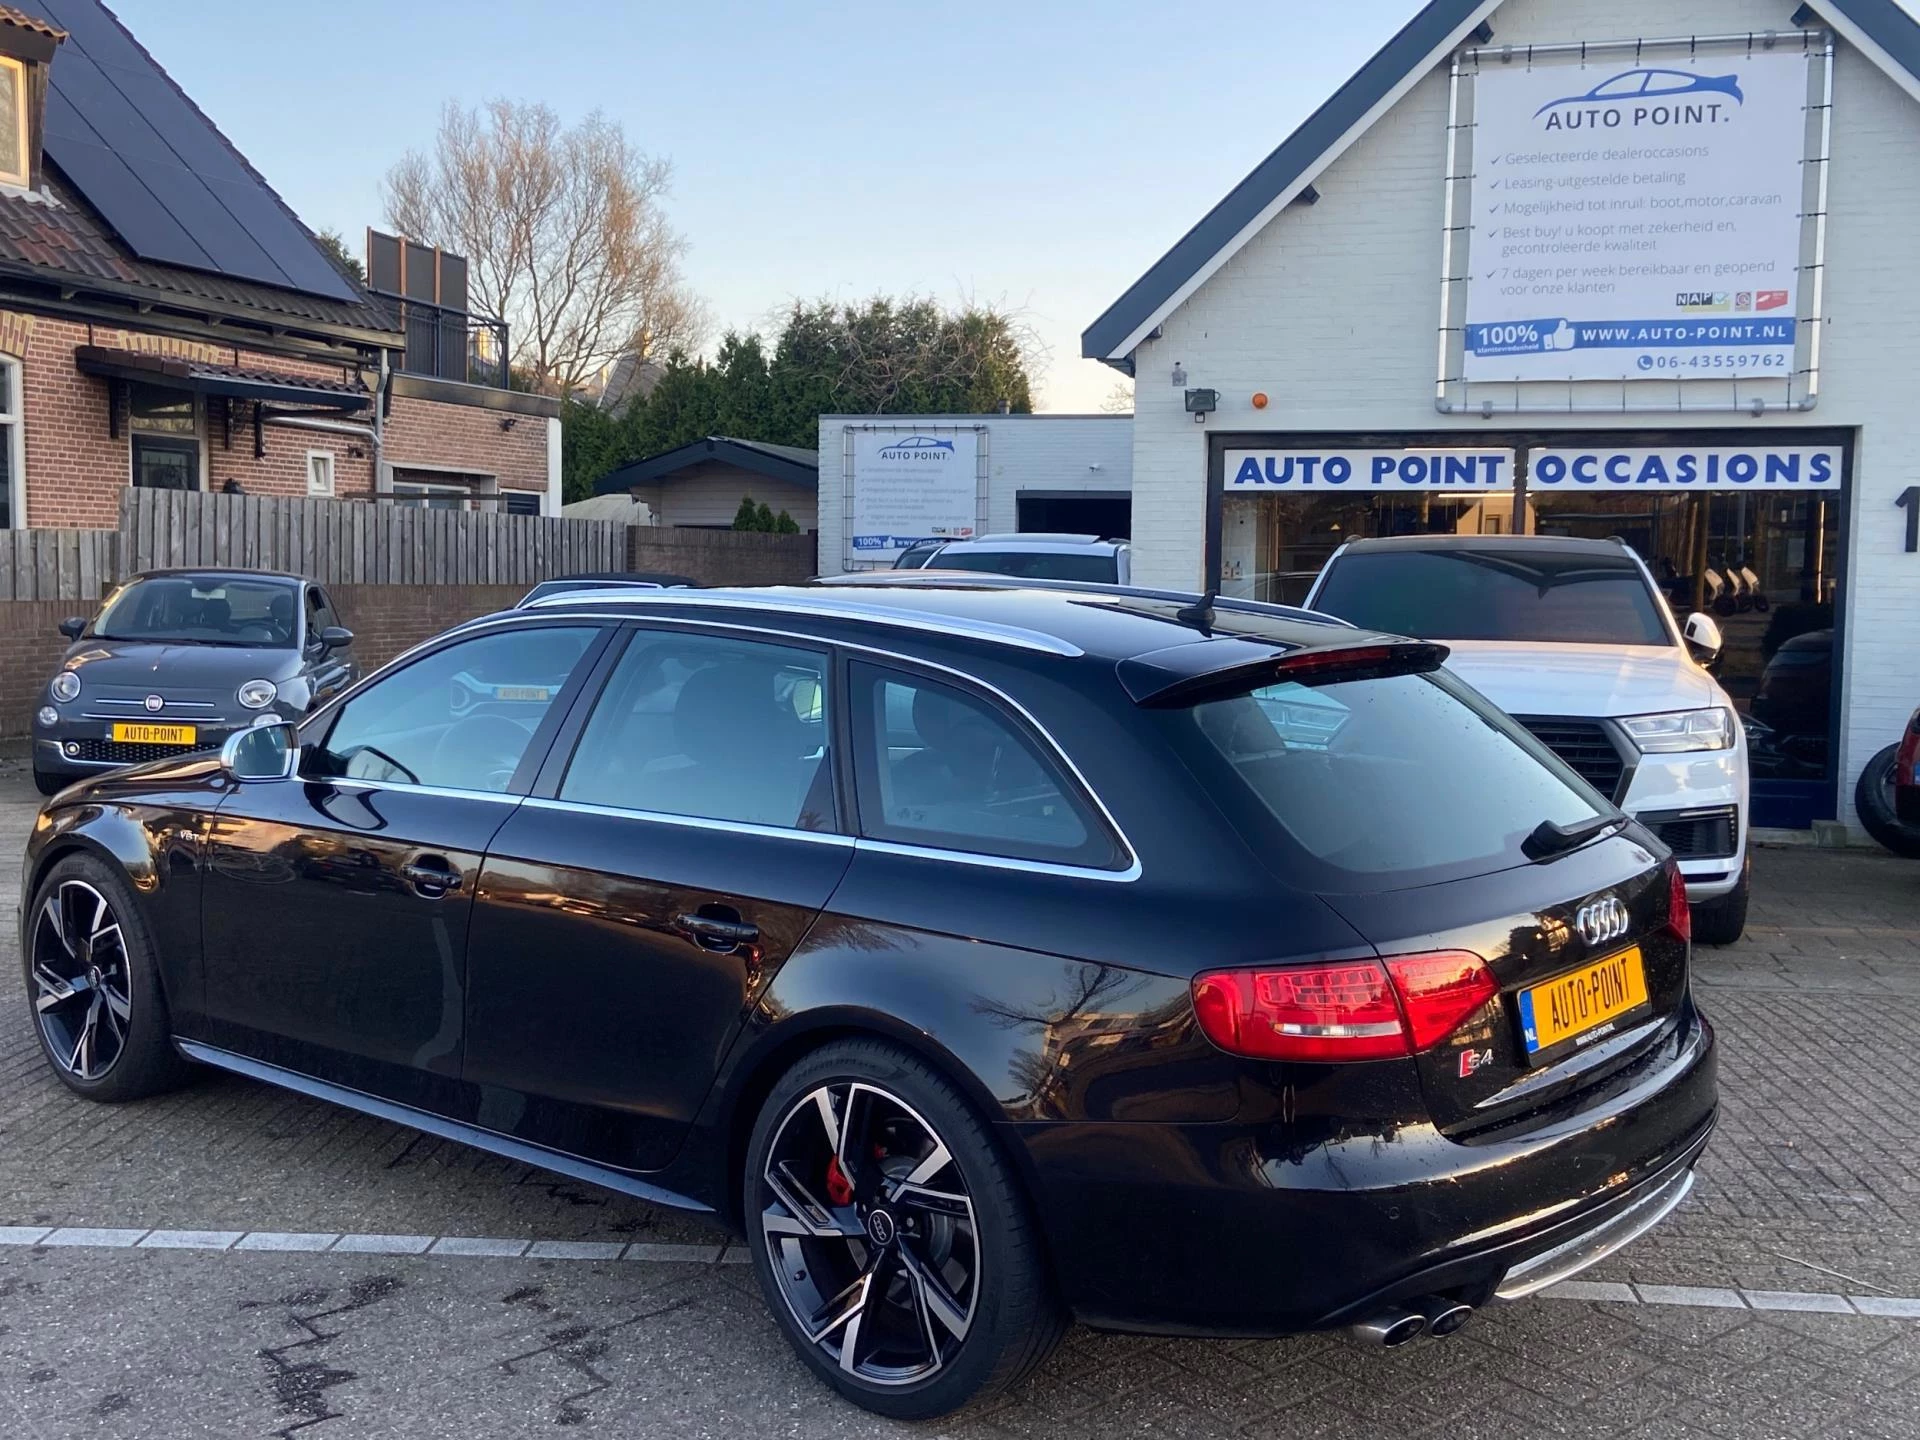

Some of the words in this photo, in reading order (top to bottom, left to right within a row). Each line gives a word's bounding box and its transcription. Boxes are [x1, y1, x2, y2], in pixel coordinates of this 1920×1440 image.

[1545, 109, 1621, 130] AUTO
[1634, 104, 1730, 126] POINT.
[1505, 149, 1599, 165] Geselecteerde
[1602, 145, 1710, 160] dealeroccasions
[1633, 171, 1686, 186] betaling
[1504, 200, 1584, 216] Mogelijkheid
[1588, 200, 1606, 211] tot
[1503, 227, 1531, 239] Best
[1535, 225, 1561, 239] buy!
[1565, 228, 1574, 236] u
[1577, 224, 1614, 238] koopt
[1619, 224, 1644, 234] met
[1648, 220, 1713, 234] zekerheid
[1501, 241, 1600, 258] gecontroleerde
[1604, 240, 1656, 252] kwaliteit
[1501, 268, 1509, 279] 7
[1512, 267, 1552, 281] dagen
[1556, 267, 1577, 279] per
[1582, 264, 1615, 276] week
[1619, 261, 1689, 276] bereikbaar
[1694, 264, 1711, 273] en
[1714, 260, 1775, 277] geopend
[1500, 285, 1528, 295] voor
[1532, 284, 1563, 294] onze
[1567, 281, 1616, 294] klanten
[1676, 292, 1713, 306] NAP
[1478, 324, 1538, 345] 100%
[1582, 325, 1786, 341] WWW.AUTO-POINT.NL
[1657, 354, 1785, 368] 06-43559762
[882, 452, 910, 460] AUTO
[1234, 457, 1351, 484] AUTO
[1371, 456, 1505, 484] POINT
[1536, 453, 1831, 484] OCCASIONS
[859, 538, 881, 547] 100%
[123, 726, 184, 742] AUTO-POINT
[1550, 957, 1630, 1033] AUTO-POINT
[1524, 1027, 1537, 1042] NL
